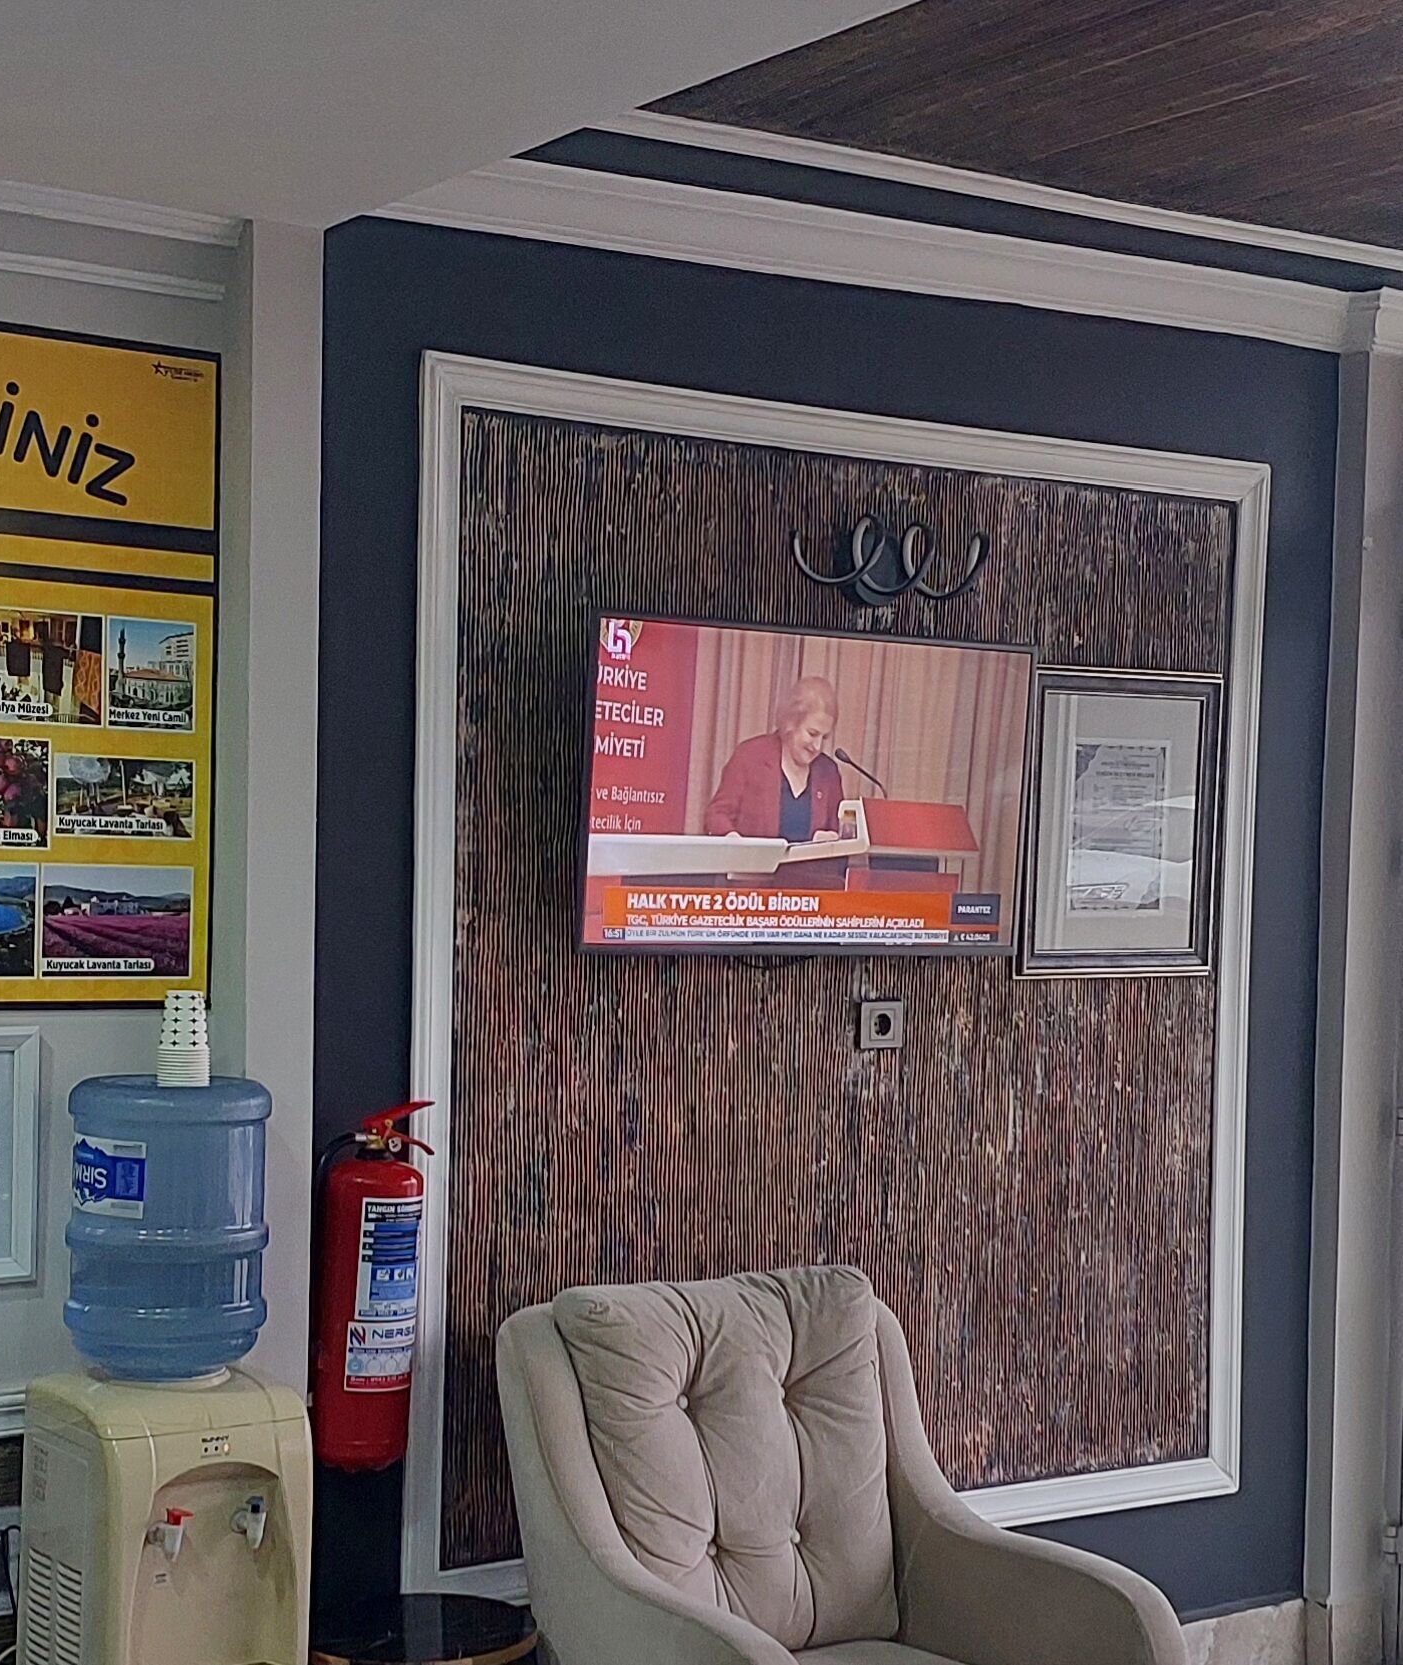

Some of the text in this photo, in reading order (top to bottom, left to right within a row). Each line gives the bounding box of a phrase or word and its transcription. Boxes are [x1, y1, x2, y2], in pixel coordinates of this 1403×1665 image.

[17, 701, 49, 715] Müzesi
[108, 709, 140, 721] Merkez
[142, 710, 161, 722] Yeni
[596, 785, 666, 805] ve Bağlantısız
[58, 817, 163, 832] Kuyucak Lavanta Tarlası
[624, 812, 642, 832] İçin
[1, 829, 33, 843] Elması
[626, 892, 820, 912] HALK TV'YE 2 ÖDÜL BİRDEN
[957, 905, 991, 915] PARANTEZ
[626, 912, 925, 930] TGC, TÜRKİYE GAZETECİLİK BAŞARI ÖDÜLLERİNİN SAHİPLERİNİ AÇIKLADI
[46, 958, 151, 973] Kuyucak Lavanta Tarlası
